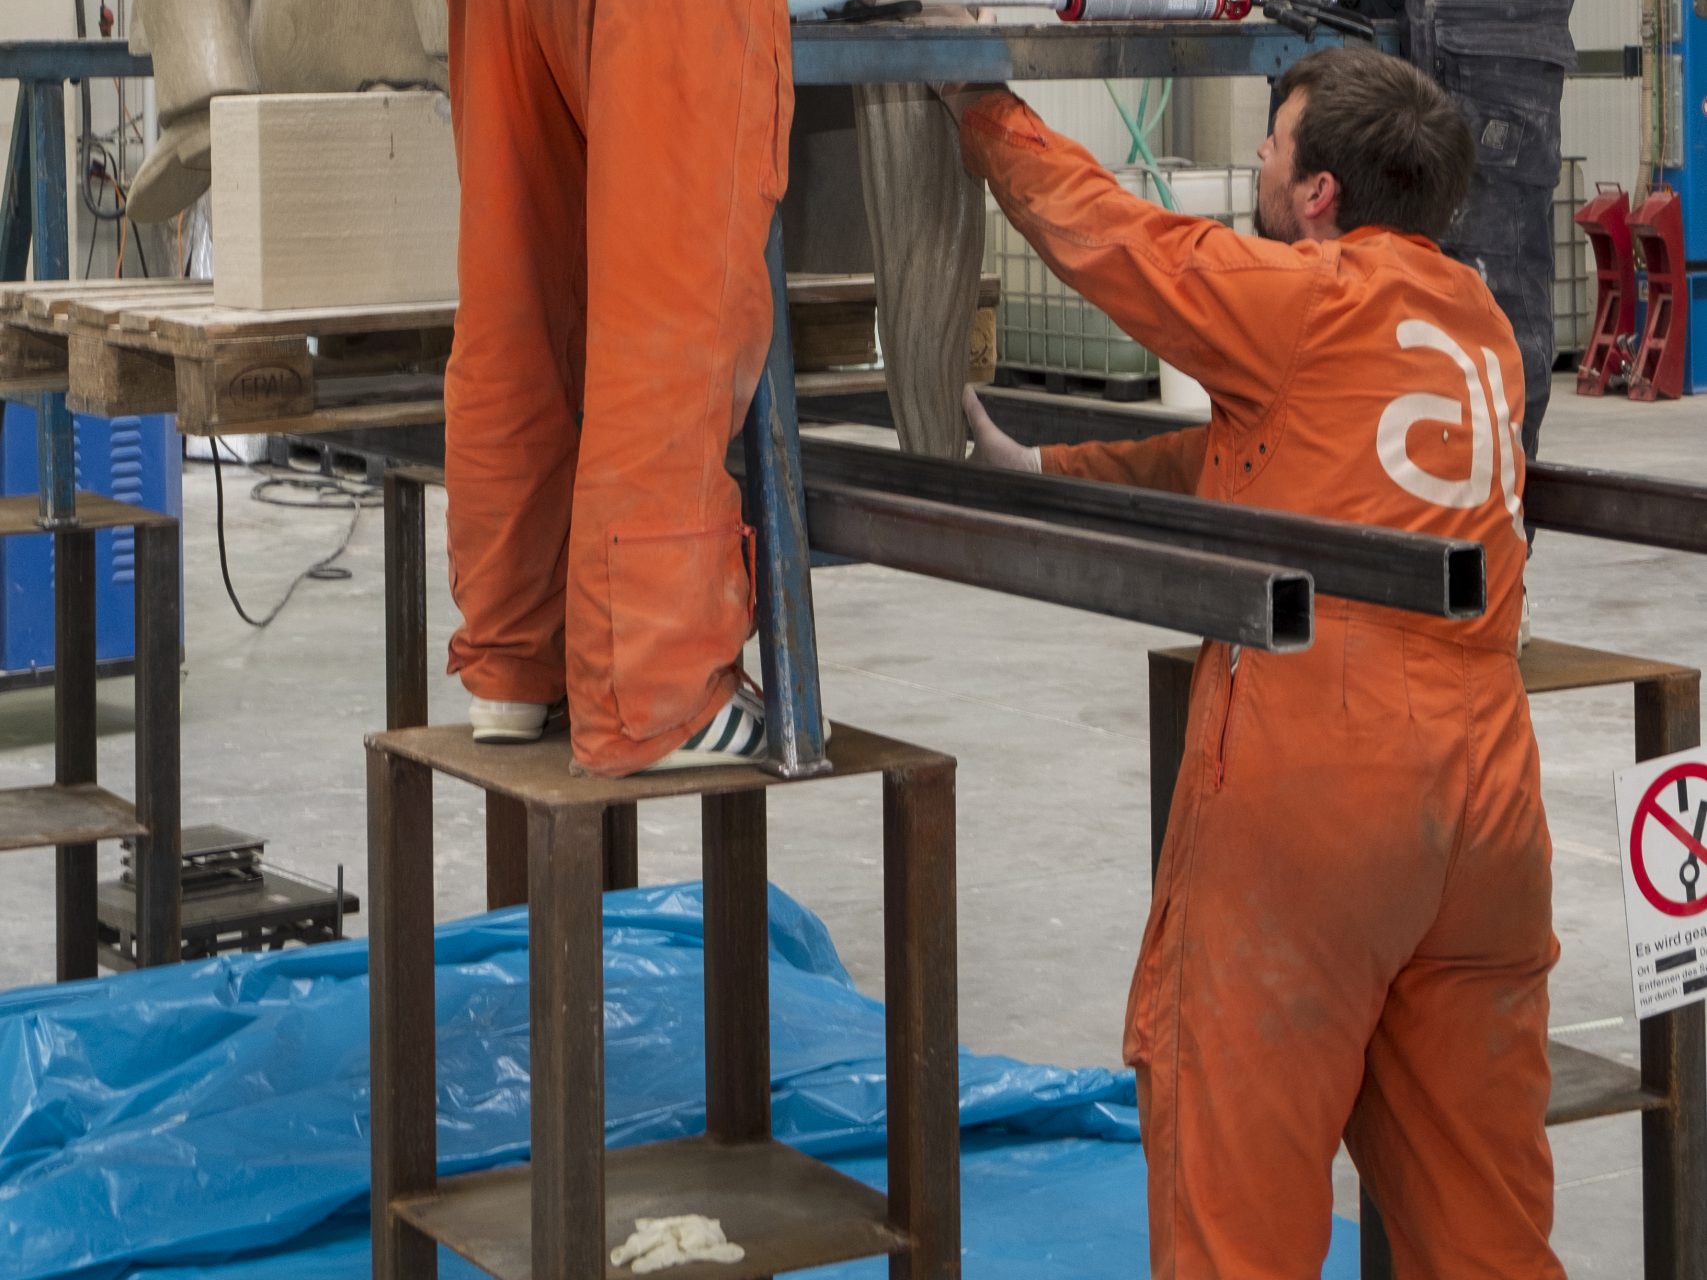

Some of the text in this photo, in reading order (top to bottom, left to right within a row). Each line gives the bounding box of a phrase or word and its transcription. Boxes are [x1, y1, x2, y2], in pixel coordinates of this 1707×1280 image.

[1635, 942, 1651, 958] Es
[1654, 930, 1681, 951] wird
[1639, 973, 1680, 994] Entfernen
[1682, 968, 1697, 979] des
[1640, 996, 1653, 1007] nur
